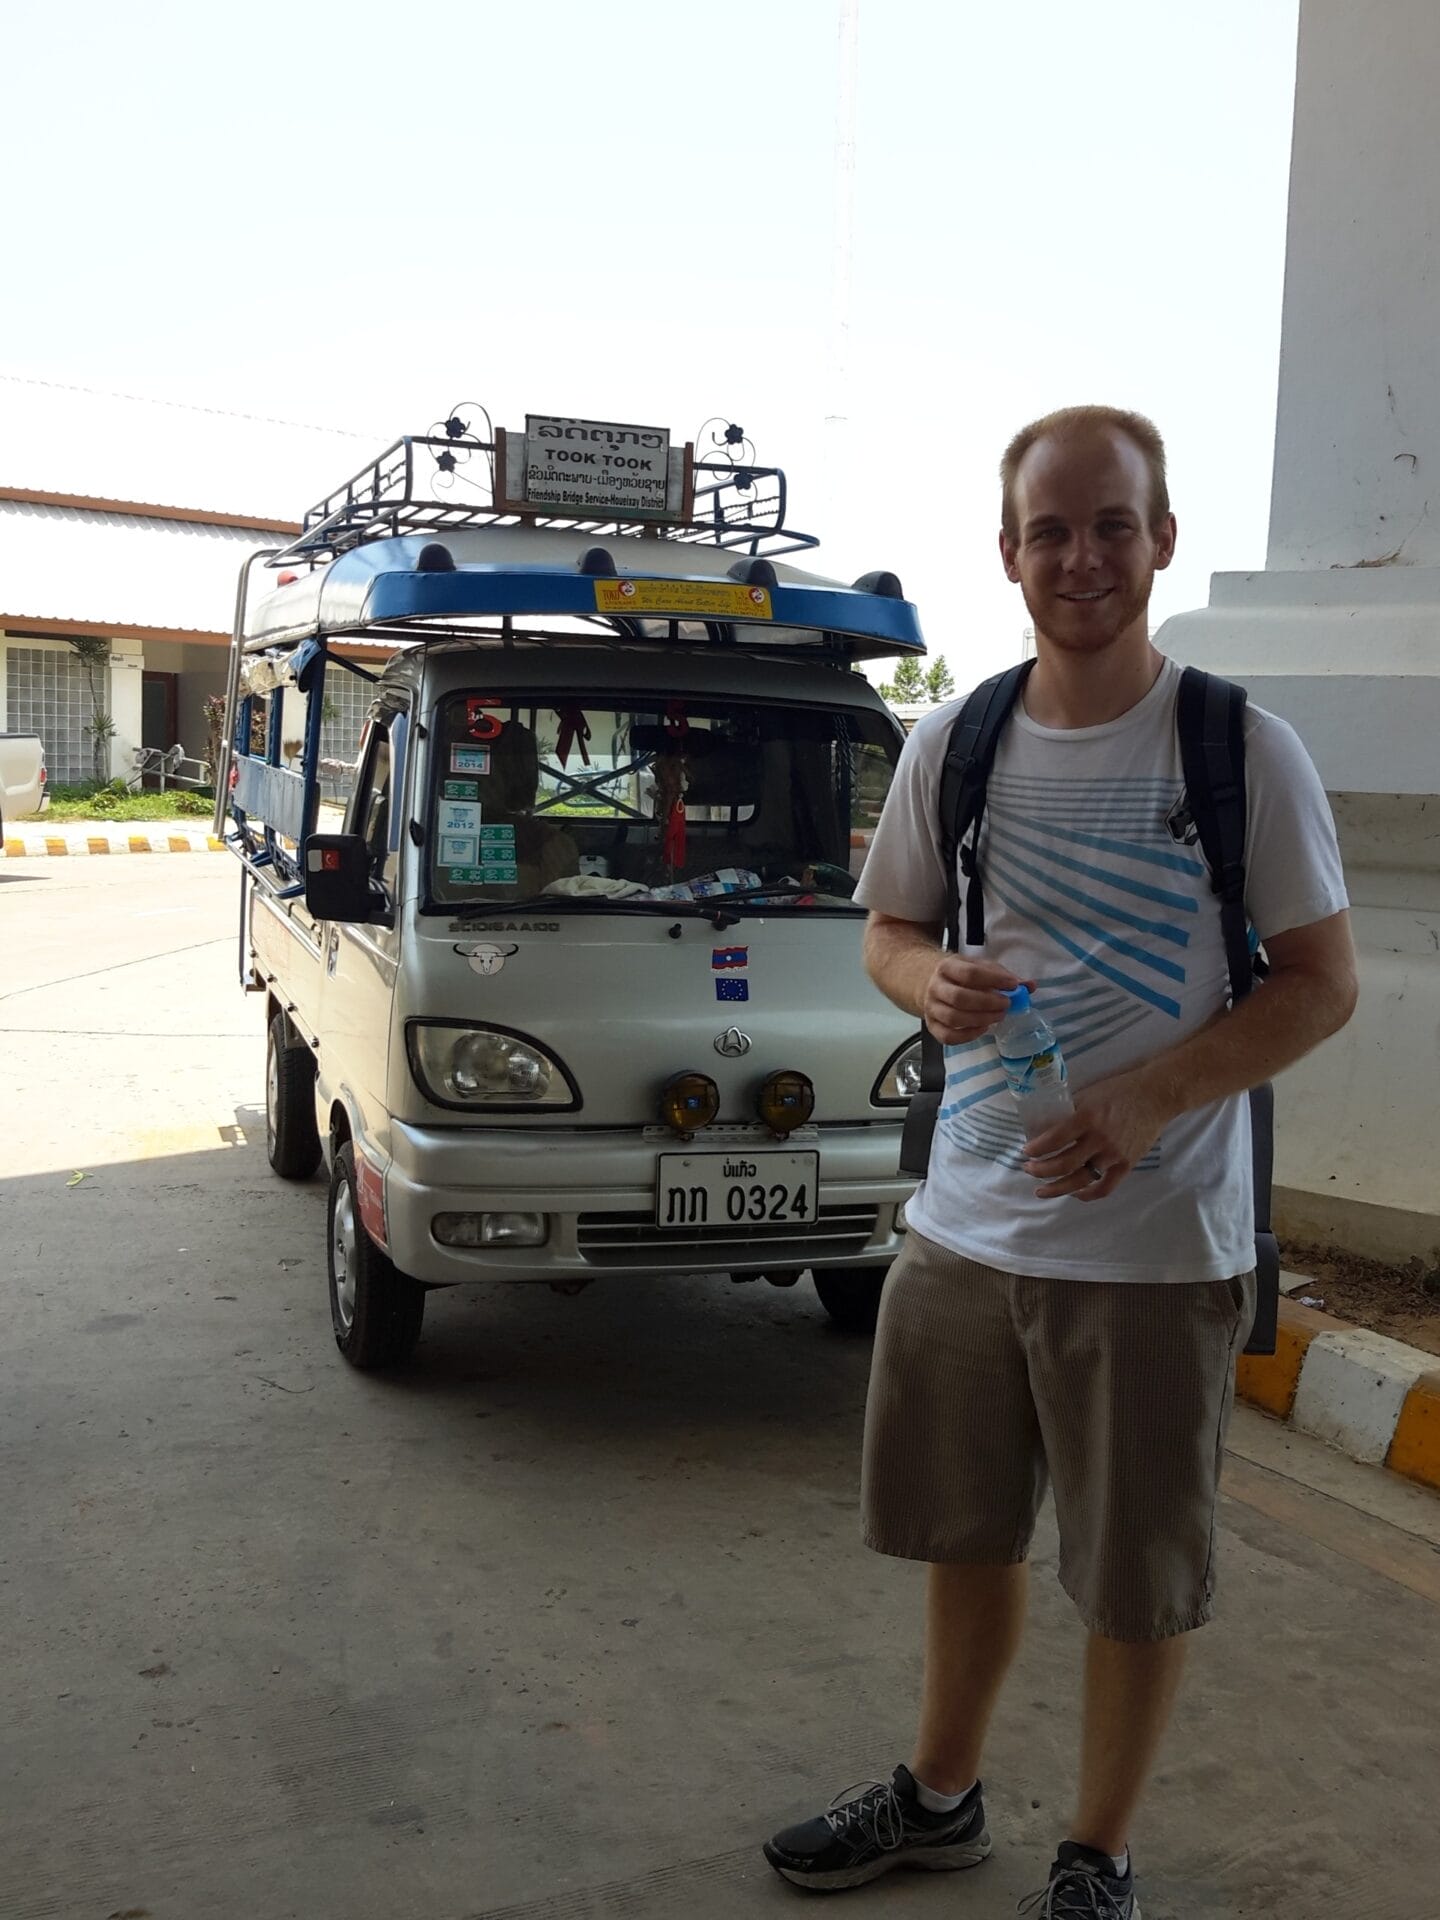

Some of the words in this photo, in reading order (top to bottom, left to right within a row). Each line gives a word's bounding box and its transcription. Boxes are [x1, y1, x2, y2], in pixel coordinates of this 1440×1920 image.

[545, 449, 597, 465] TOOK
[602, 454, 652, 471] TOOK
[528, 488, 561, 504] Friendship
[563, 491, 584, 505] Bridge
[641, 496, 664, 508] District
[466, 697, 503, 740] 5
[457, 761, 483, 769] 2014
[446, 821, 475, 829] 2012
[726, 1184, 809, 1222] 0324
